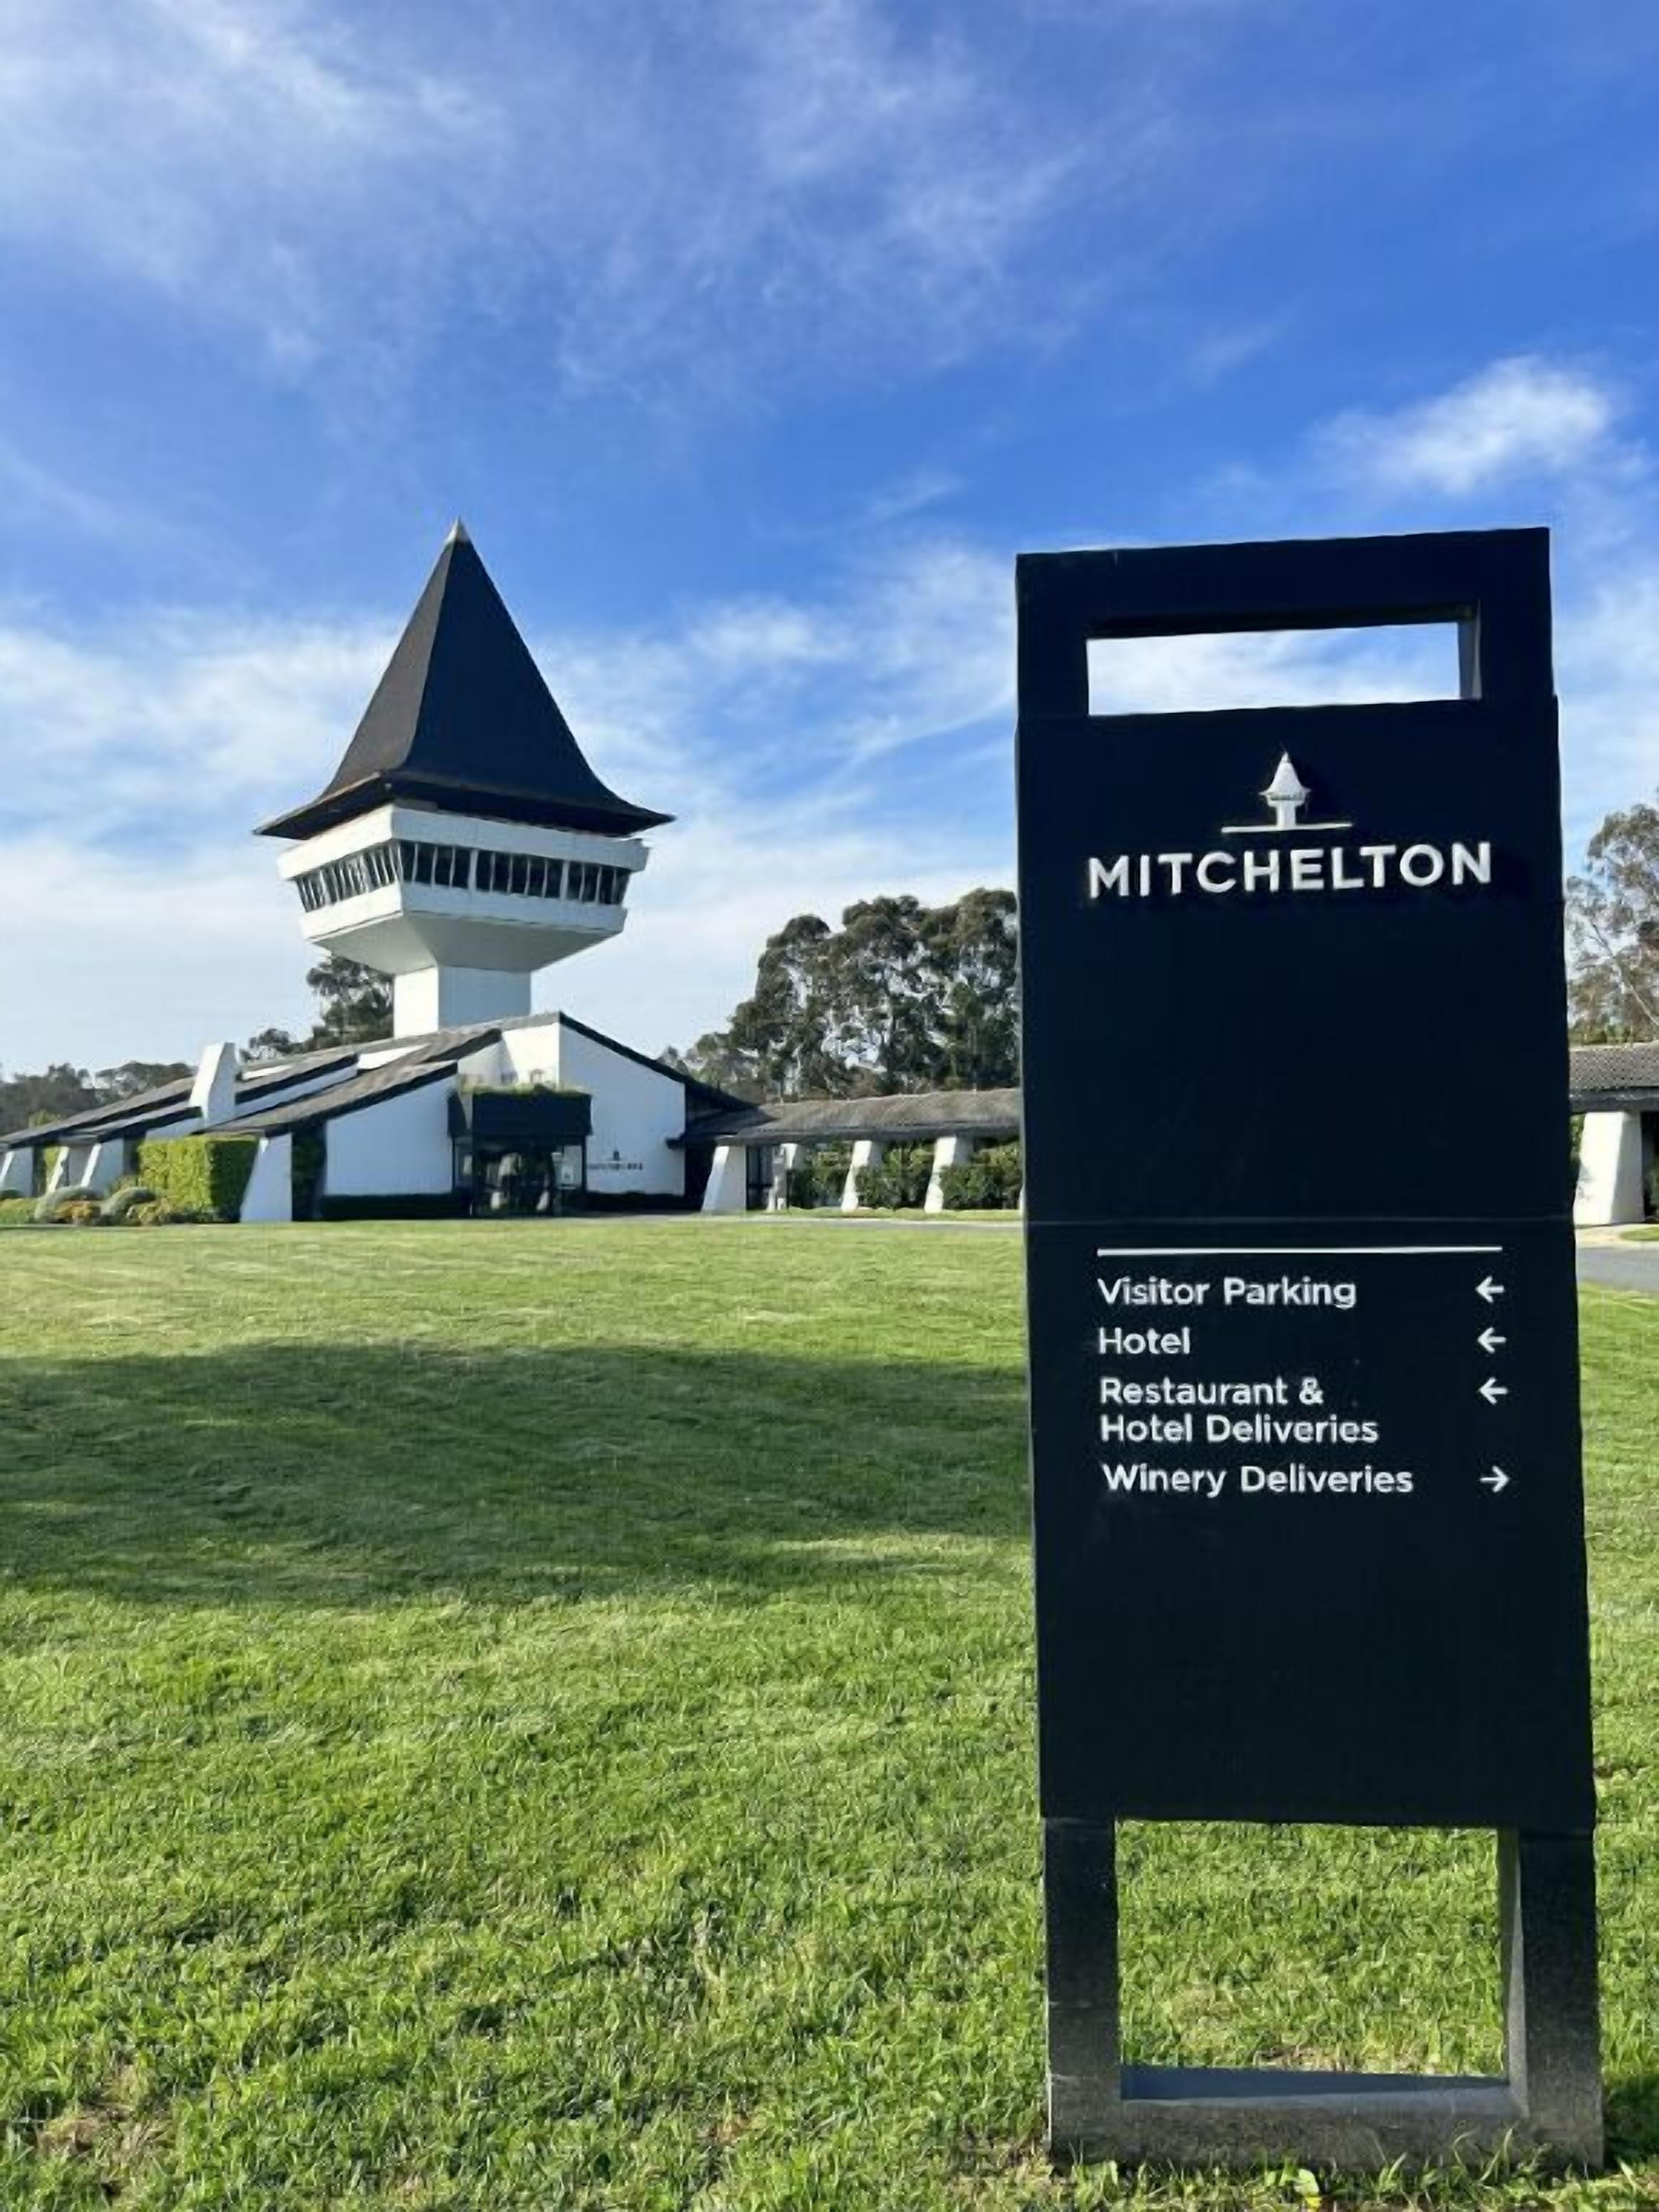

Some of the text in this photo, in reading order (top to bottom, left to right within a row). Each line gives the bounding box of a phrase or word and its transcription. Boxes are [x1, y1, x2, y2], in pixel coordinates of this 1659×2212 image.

[1088, 841, 1492, 899] MITCHELTON
[1097, 1276, 1357, 1310] Visitor Parking
[1098, 1326, 1191, 1355] Hotel
[1100, 1376, 1324, 1406] Restaurant &
[1100, 1413, 1379, 1444] Hotel Deliveries
[1102, 1463, 1413, 1498] Winery Deliveries
